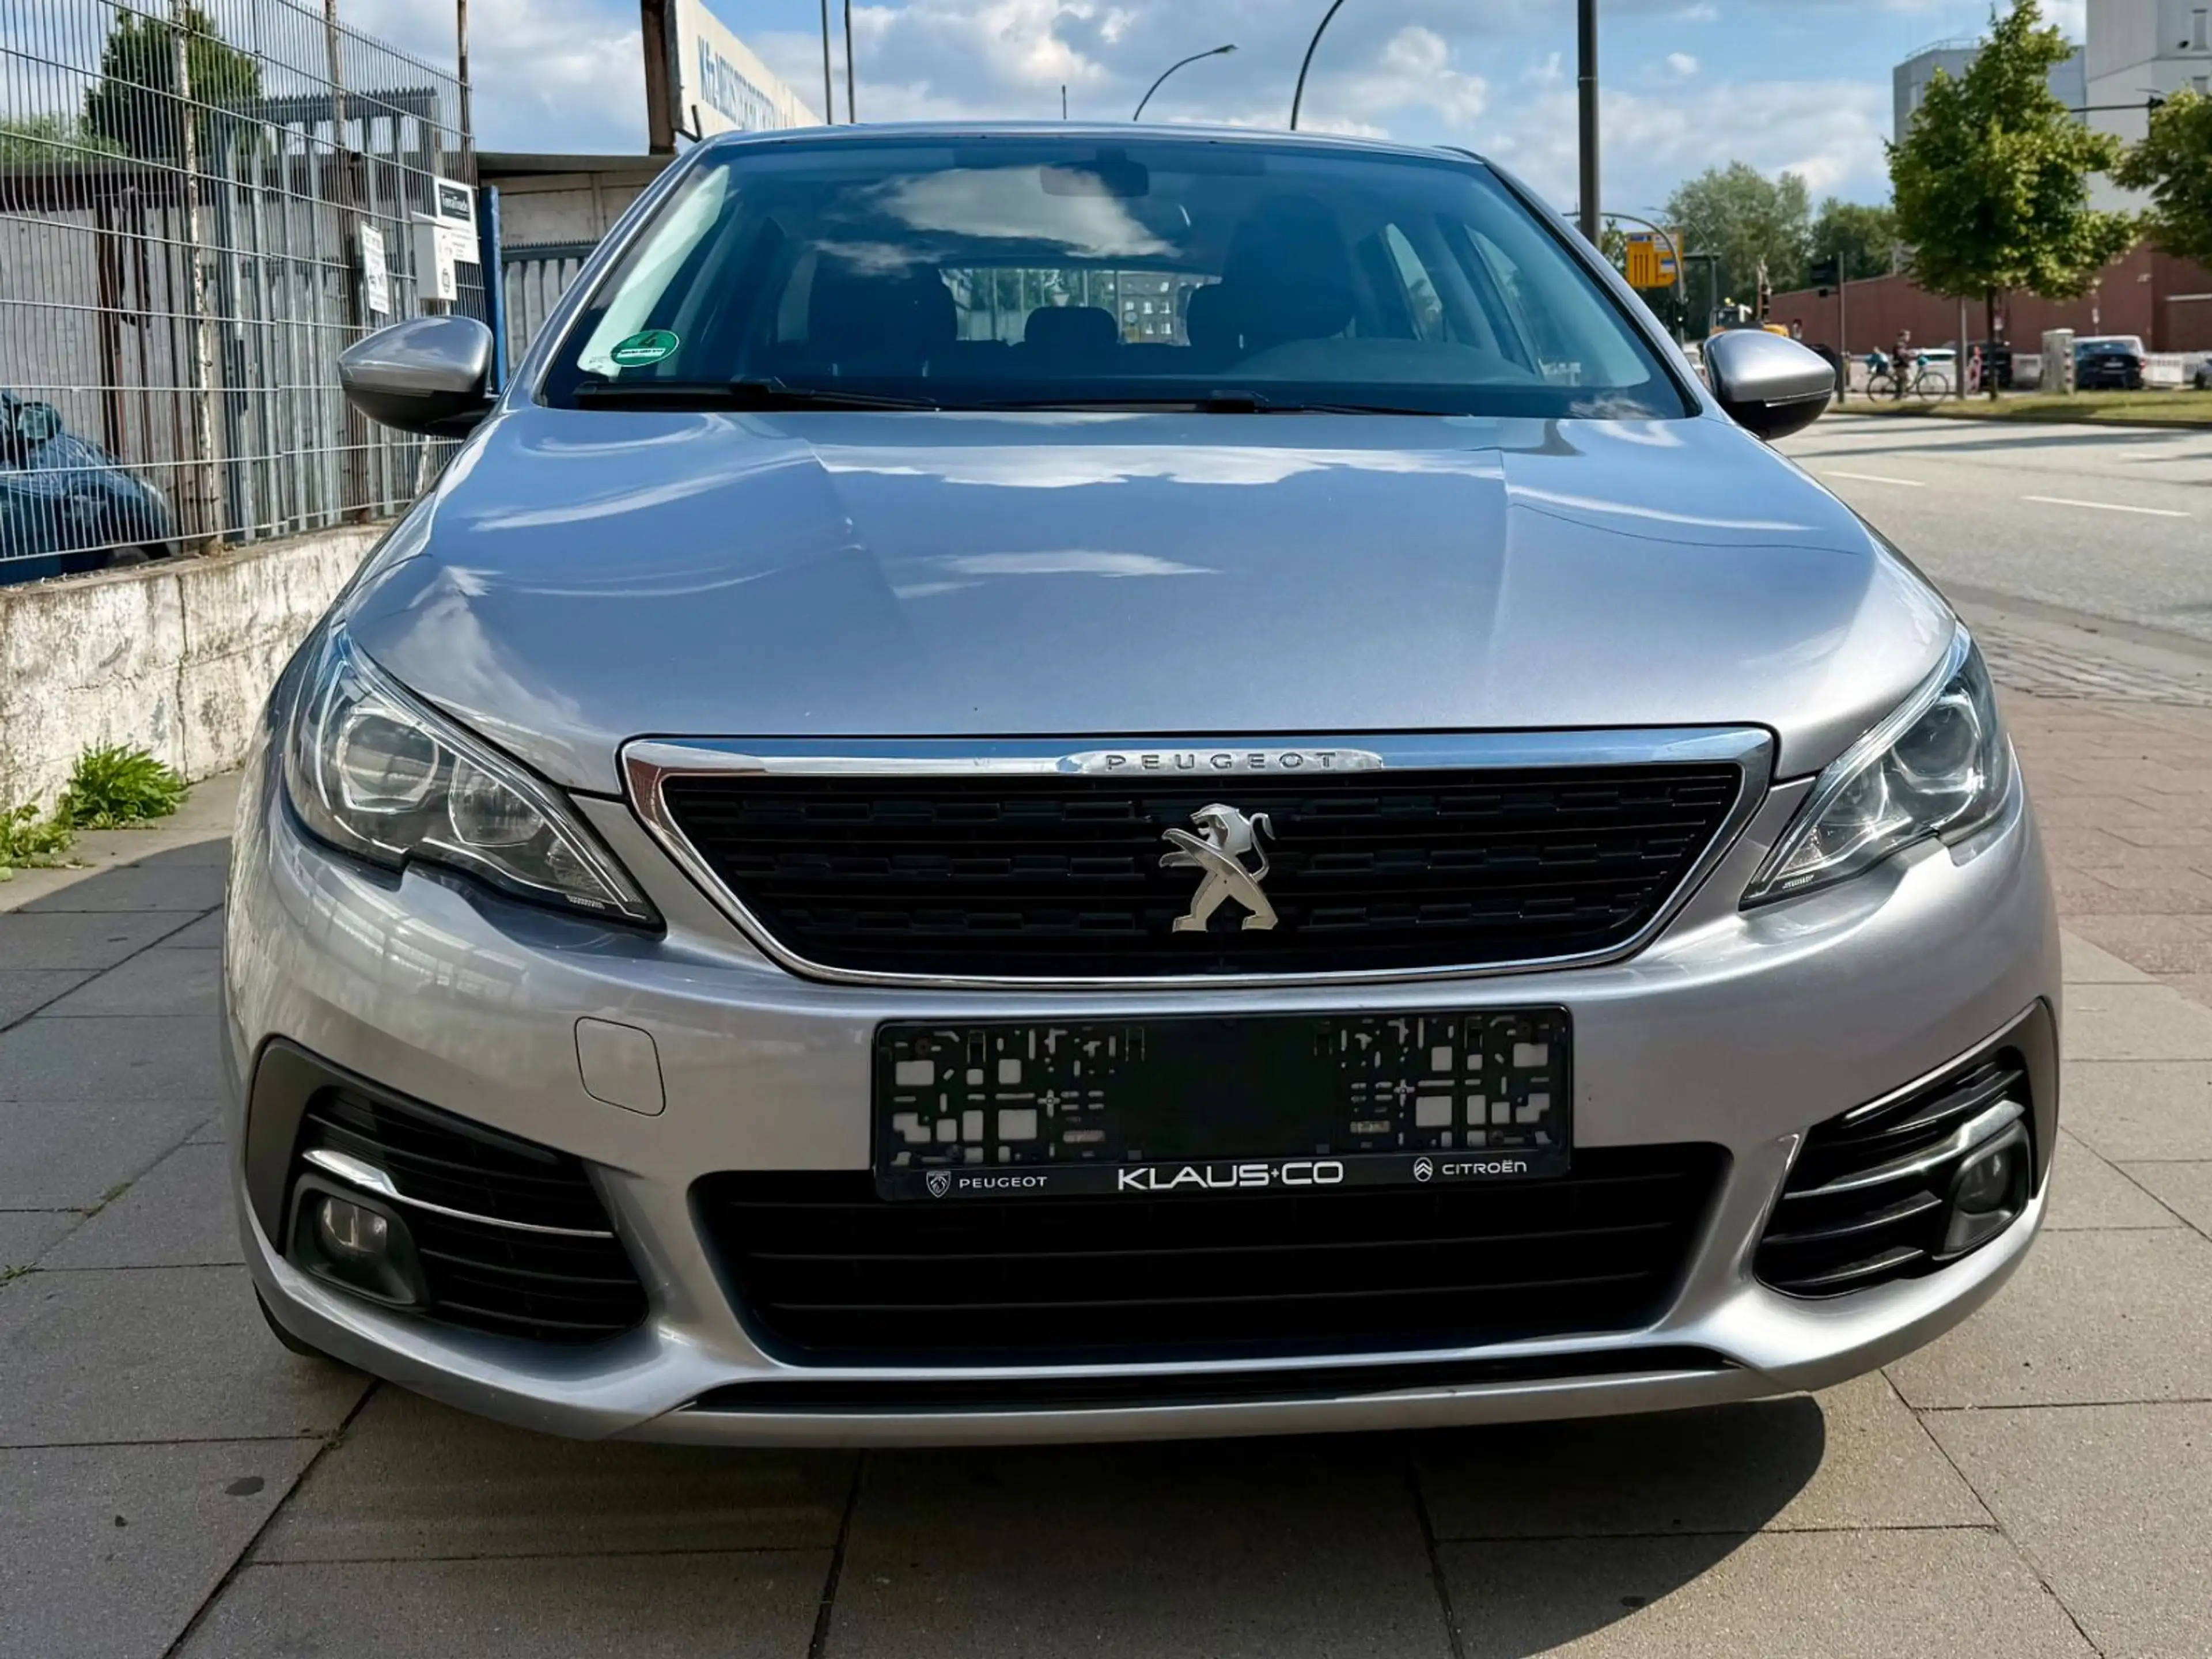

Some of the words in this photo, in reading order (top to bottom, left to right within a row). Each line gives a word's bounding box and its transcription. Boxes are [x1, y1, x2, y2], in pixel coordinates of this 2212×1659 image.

[1105, 752, 1336, 771] PEUGEOT
[1441, 1160, 1528, 1175] CITROËN
[959, 1176, 1048, 1190] PEUGEOT
